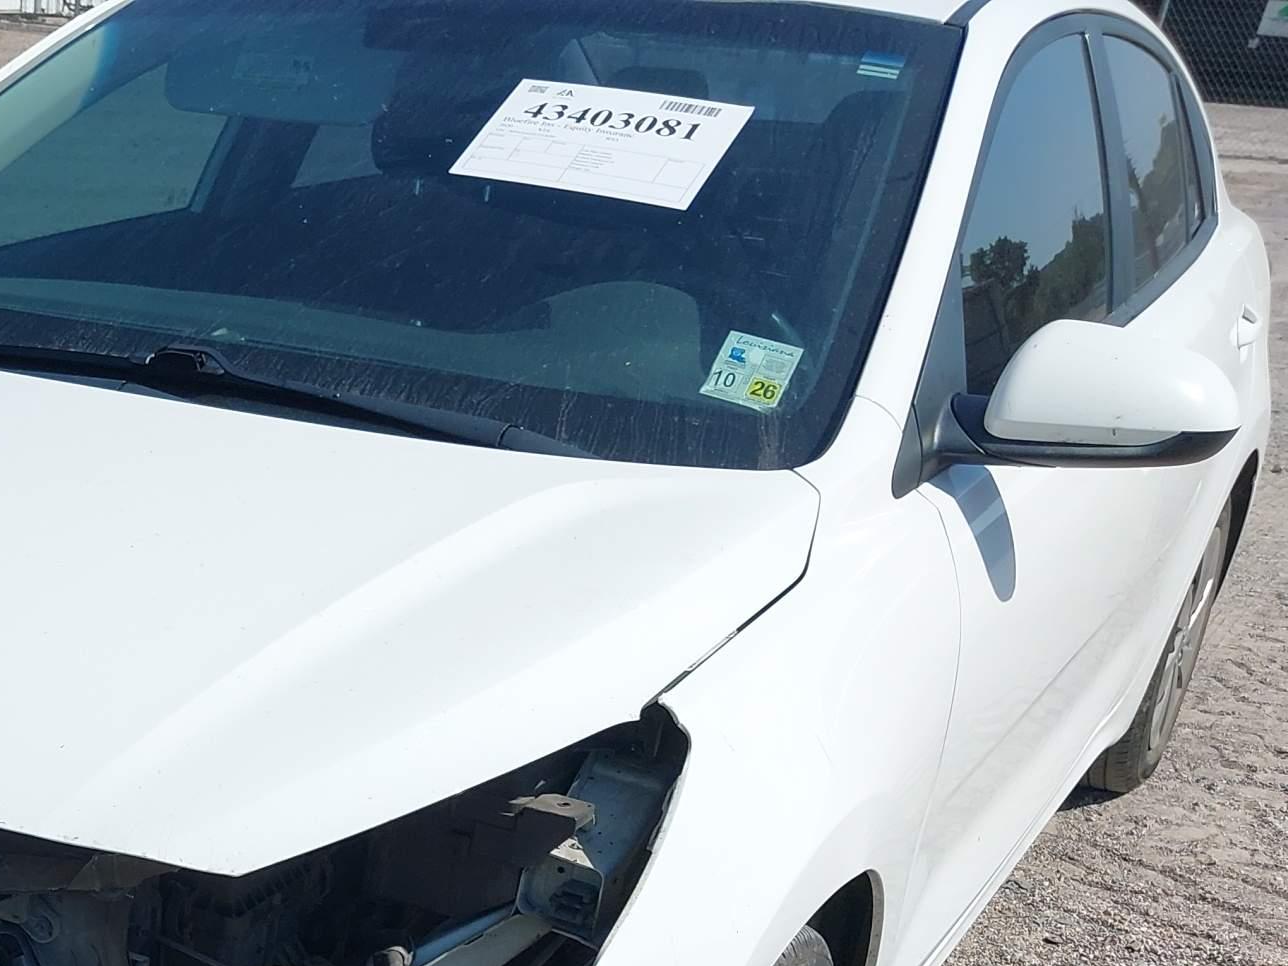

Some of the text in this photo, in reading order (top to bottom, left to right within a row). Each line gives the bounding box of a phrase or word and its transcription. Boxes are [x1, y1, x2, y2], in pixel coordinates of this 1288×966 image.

[523, 102, 703, 142] 43403081
[735, 335, 795, 358] Louisiana
[713, 369, 736, 388] 10
[749, 381, 778, 400] 26
